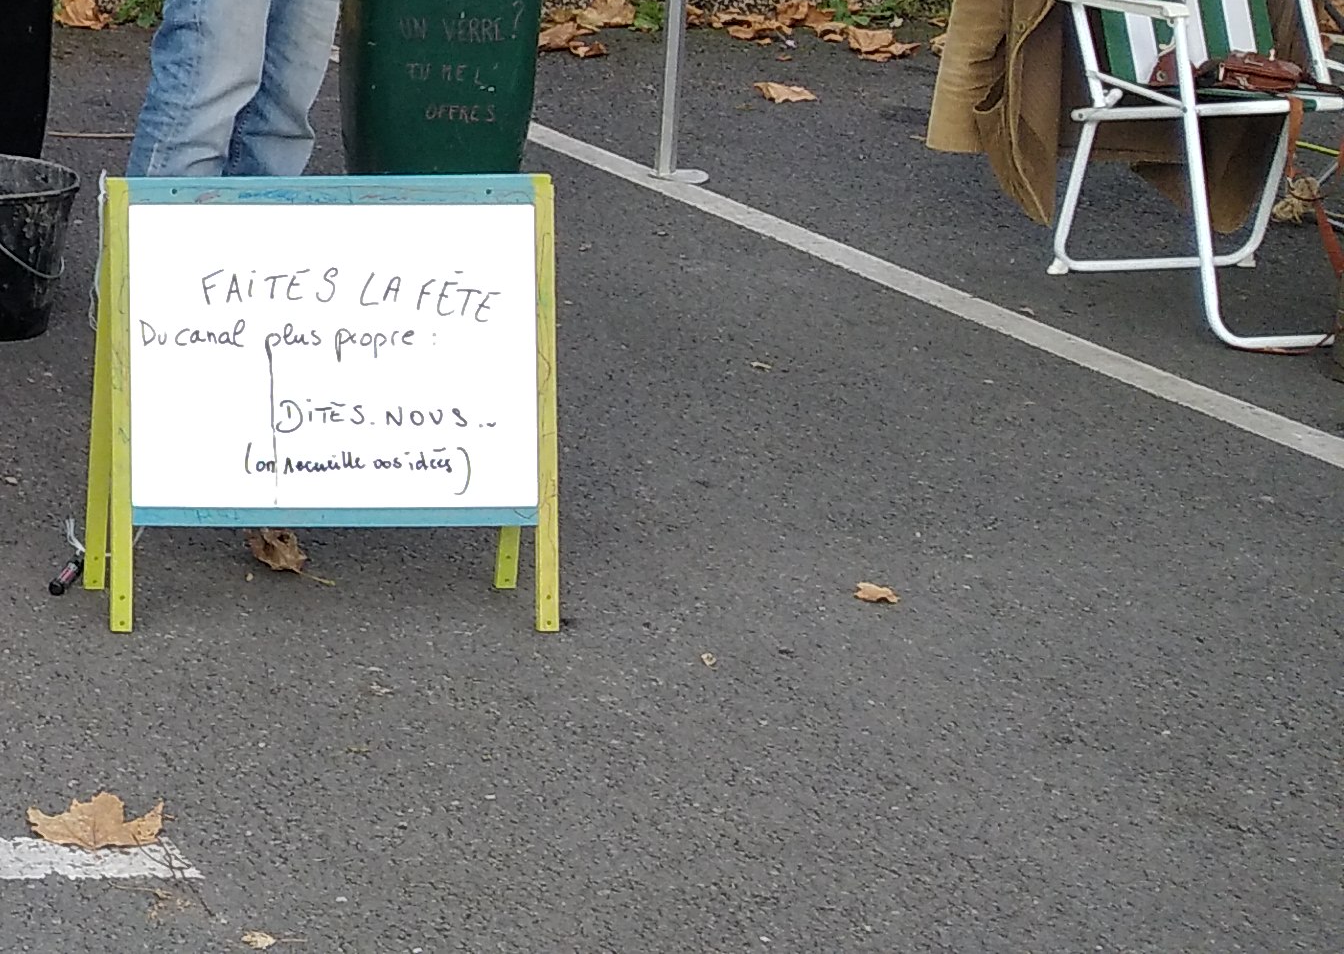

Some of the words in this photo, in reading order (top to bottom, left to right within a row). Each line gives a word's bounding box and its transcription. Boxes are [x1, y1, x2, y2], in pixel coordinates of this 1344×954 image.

[399, 15, 427, 40] UN
[425, 104, 496, 124] OFFRES
[360, 271, 402, 306] LA
[174, 318, 245, 348] canal
[264, 322, 322, 372] plus
[283, 450, 366, 475] recueille
